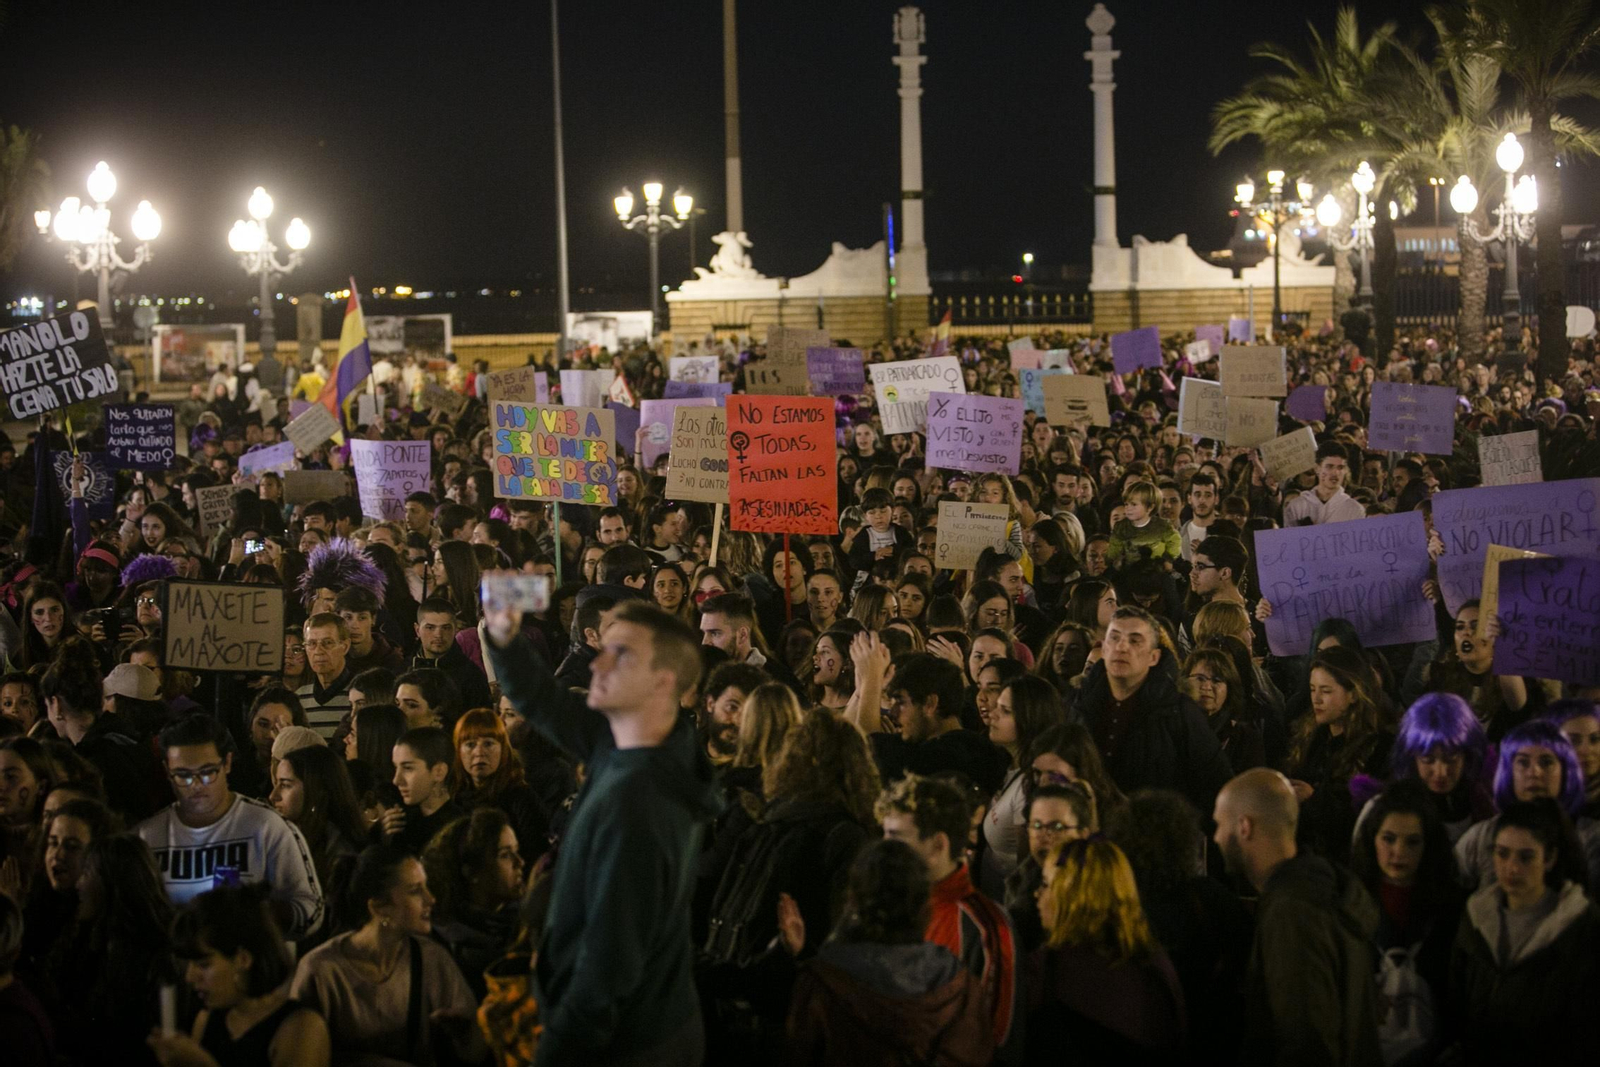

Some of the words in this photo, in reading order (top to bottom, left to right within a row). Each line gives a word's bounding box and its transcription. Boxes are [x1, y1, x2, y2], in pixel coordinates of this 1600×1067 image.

[0, 311, 90, 361] MANOLO
[0, 353, 58, 395] HAZTE
[55, 346, 83, 376] LA
[503, 374, 516, 385] ES
[518, 373, 531, 384] LA
[886, 363, 942, 382] PATRIARCADO
[9, 387, 60, 420] CENA
[55, 371, 86, 404] TÚ
[83, 362, 119, 398] SOLO
[503, 384, 526, 395] HORA
[108, 407, 131, 421] Nos
[496, 403, 539, 433] HOY
[540, 409, 580, 436] VAS
[584, 412, 602, 438] A
[677, 411, 700, 435] Las
[738, 403, 763, 425] NO
[773, 405, 826, 424] ESTAMOS
[956, 406, 994, 425] ELIJO
[136, 424, 156, 437] que
[931, 425, 974, 444] VISTO
[989, 430, 1006, 438] CON
[496, 429, 534, 455] SER
[536, 433, 559, 457] LA
[560, 437, 609, 464] MUJER
[989, 438, 1016, 447] QUIEN
[383, 444, 427, 464] PONTE
[935, 449, 956, 460] me
[496, 455, 535, 478] QUE
[537, 457, 562, 479] TE
[564, 459, 588, 483] DE
[672, 455, 697, 469] LUCHO
[699, 456, 729, 473] CON
[376, 468, 418, 487] ZAPATOS
[419, 472, 429, 488] Y
[685, 477, 696, 489] NO
[739, 466, 789, 484] FALTAN
[797, 465, 826, 480] LAS
[200, 487, 229, 501] SOMOS
[382, 487, 395, 496] DE
[499, 474, 523, 497] LA
[522, 477, 562, 498] GANA
[562, 481, 584, 500] DE
[201, 499, 226, 511] GRITO
[203, 510, 220, 522] QUE
[1450, 525, 1480, 556] NO
[1487, 510, 1580, 549] VIOLAR
[1261, 542, 1288, 567] el
[1298, 520, 1420, 562] PATRIARCADO
[1317, 572, 1341, 583] me
[1345, 566, 1364, 581] da
[173, 586, 270, 624] MAXETE
[1503, 601, 1528, 626] de
[201, 622, 227, 643] AL
[169, 636, 274, 668] MAXOTE
